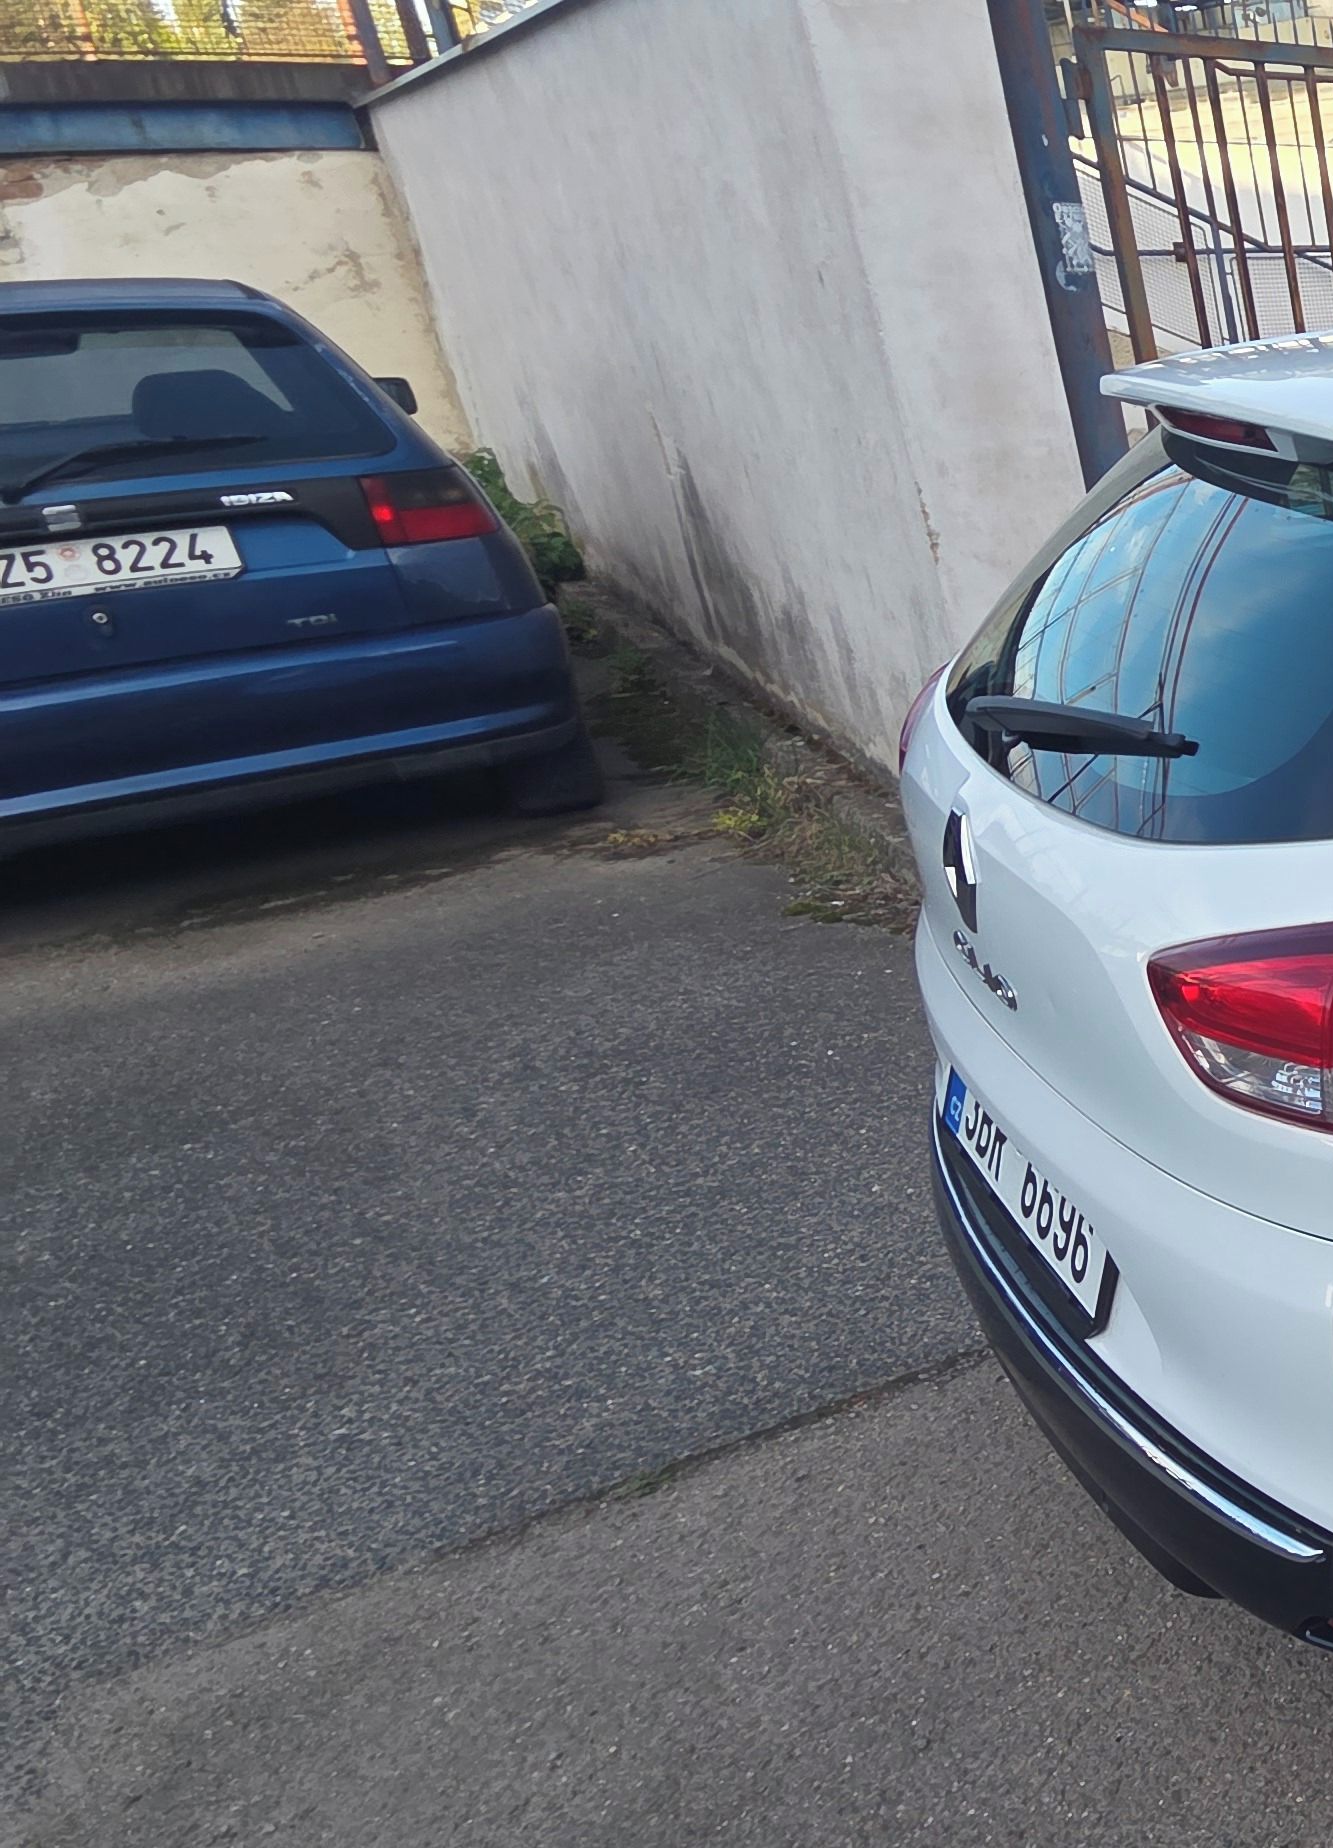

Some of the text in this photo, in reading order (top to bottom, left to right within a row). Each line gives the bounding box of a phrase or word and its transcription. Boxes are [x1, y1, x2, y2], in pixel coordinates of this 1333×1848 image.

[220, 491, 294, 507] IBIZA
[91, 532, 214, 576] 8224
[1020, 1160, 1094, 1284] 6696
